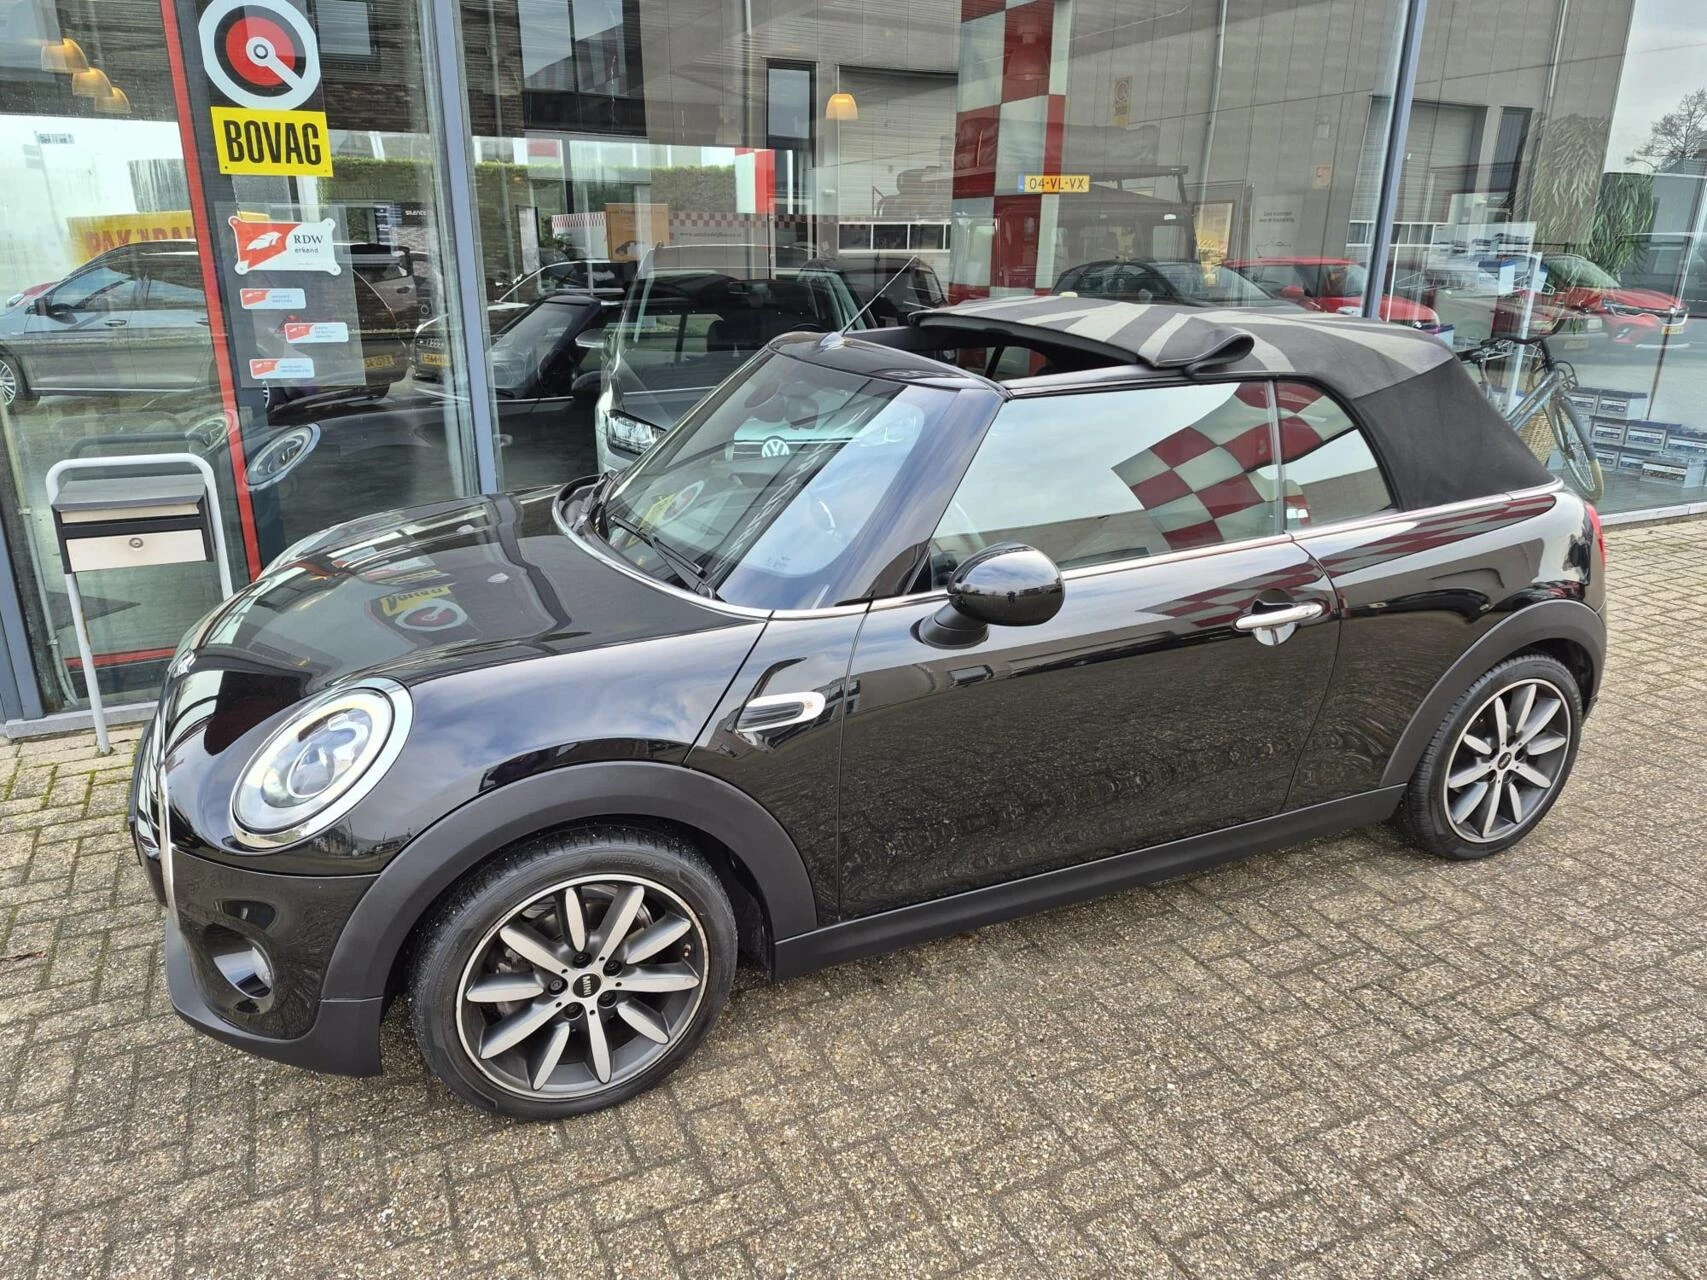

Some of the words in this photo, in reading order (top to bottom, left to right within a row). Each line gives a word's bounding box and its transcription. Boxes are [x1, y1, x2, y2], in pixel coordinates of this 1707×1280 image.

[222, 120, 322, 166] BOVAG
[1029, 177, 1084, 190] 04-VL-VX
[293, 234, 324, 244] RDW
[582, 975, 592, 996] MINI
